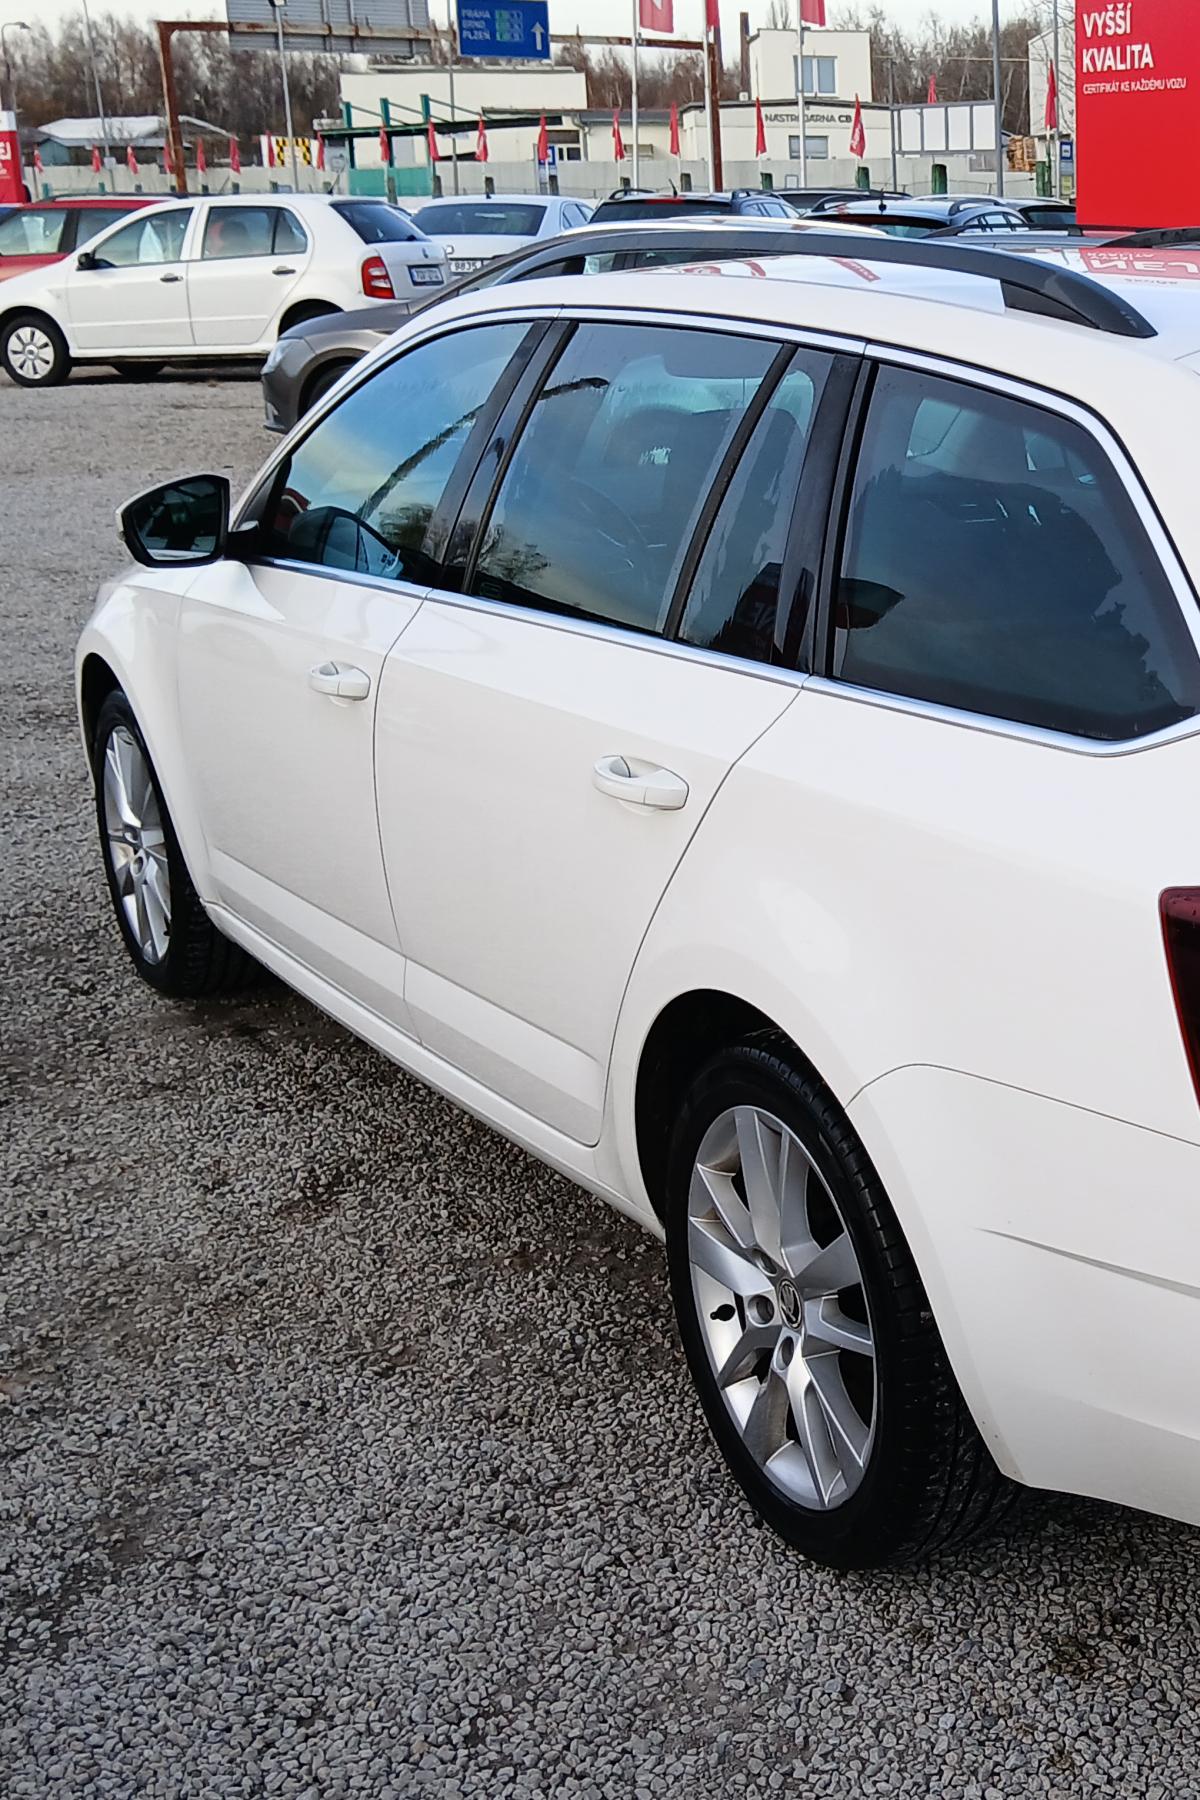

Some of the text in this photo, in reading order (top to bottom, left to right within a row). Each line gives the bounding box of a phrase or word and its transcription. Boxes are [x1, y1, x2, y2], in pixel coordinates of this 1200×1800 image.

[1083, 3, 1132, 37] VYŠŠÍ
[1083, 43, 1154, 73] KVALITA
[1166, 77, 1187, 89] VOZU
